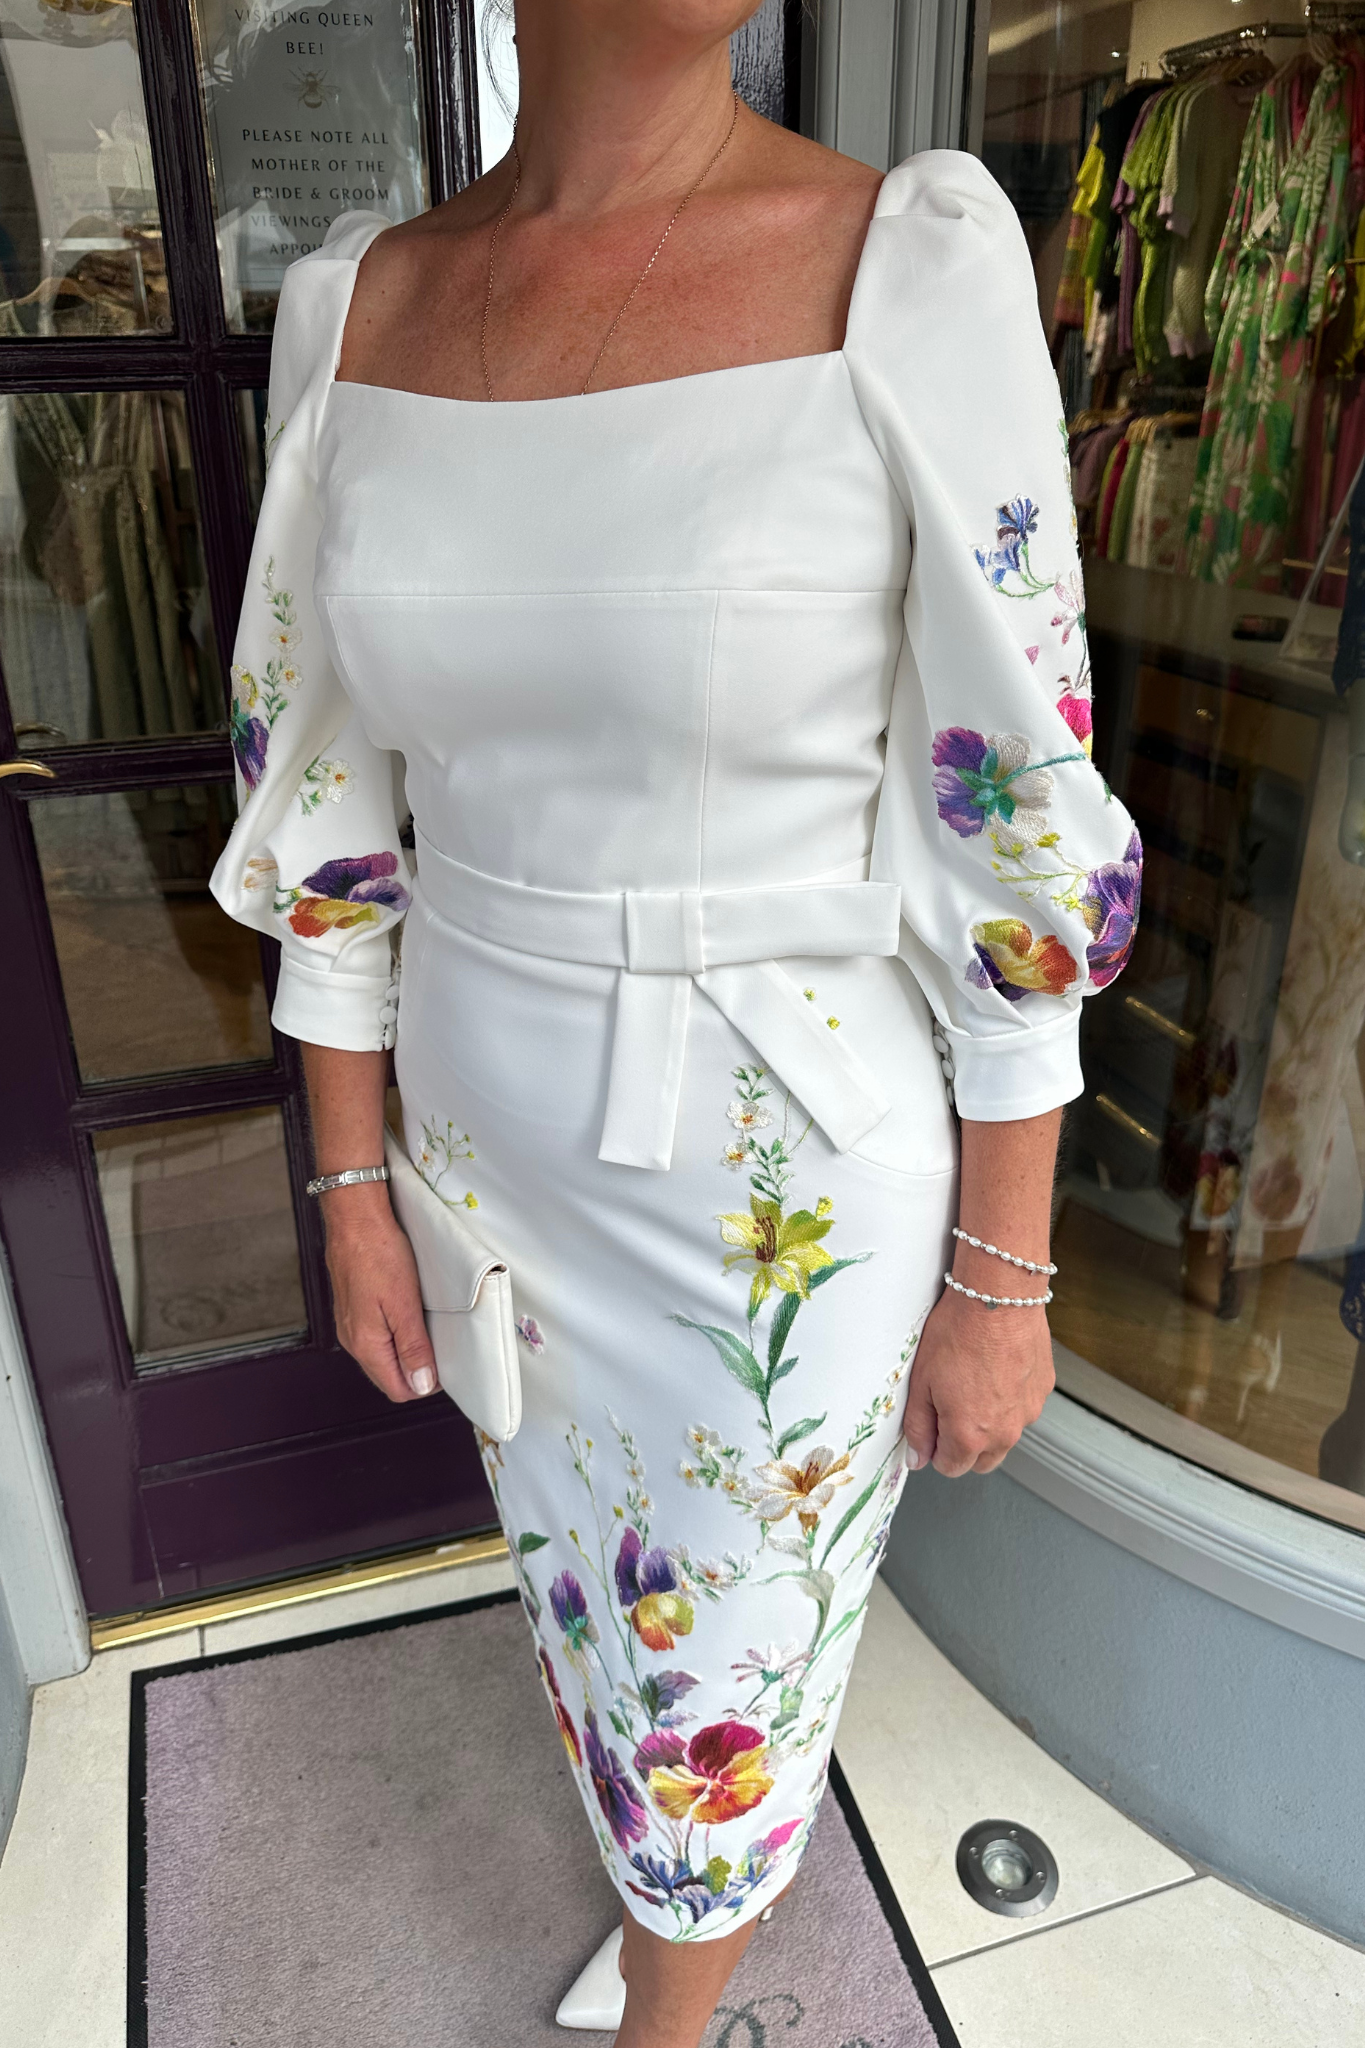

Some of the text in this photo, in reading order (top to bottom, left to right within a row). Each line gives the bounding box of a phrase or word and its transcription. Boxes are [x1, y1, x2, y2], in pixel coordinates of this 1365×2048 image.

[234, 9, 374, 28] VISITING QUEEN
[285, 41, 324, 55] BEE!
[242, 128, 389, 144] PLEASE NOTE ALL
[251, 158, 386, 173] MOTHER OF THE
[252, 186, 389, 201] BRIDE & GROOM
[250, 215, 332, 228] VIEWINGS
